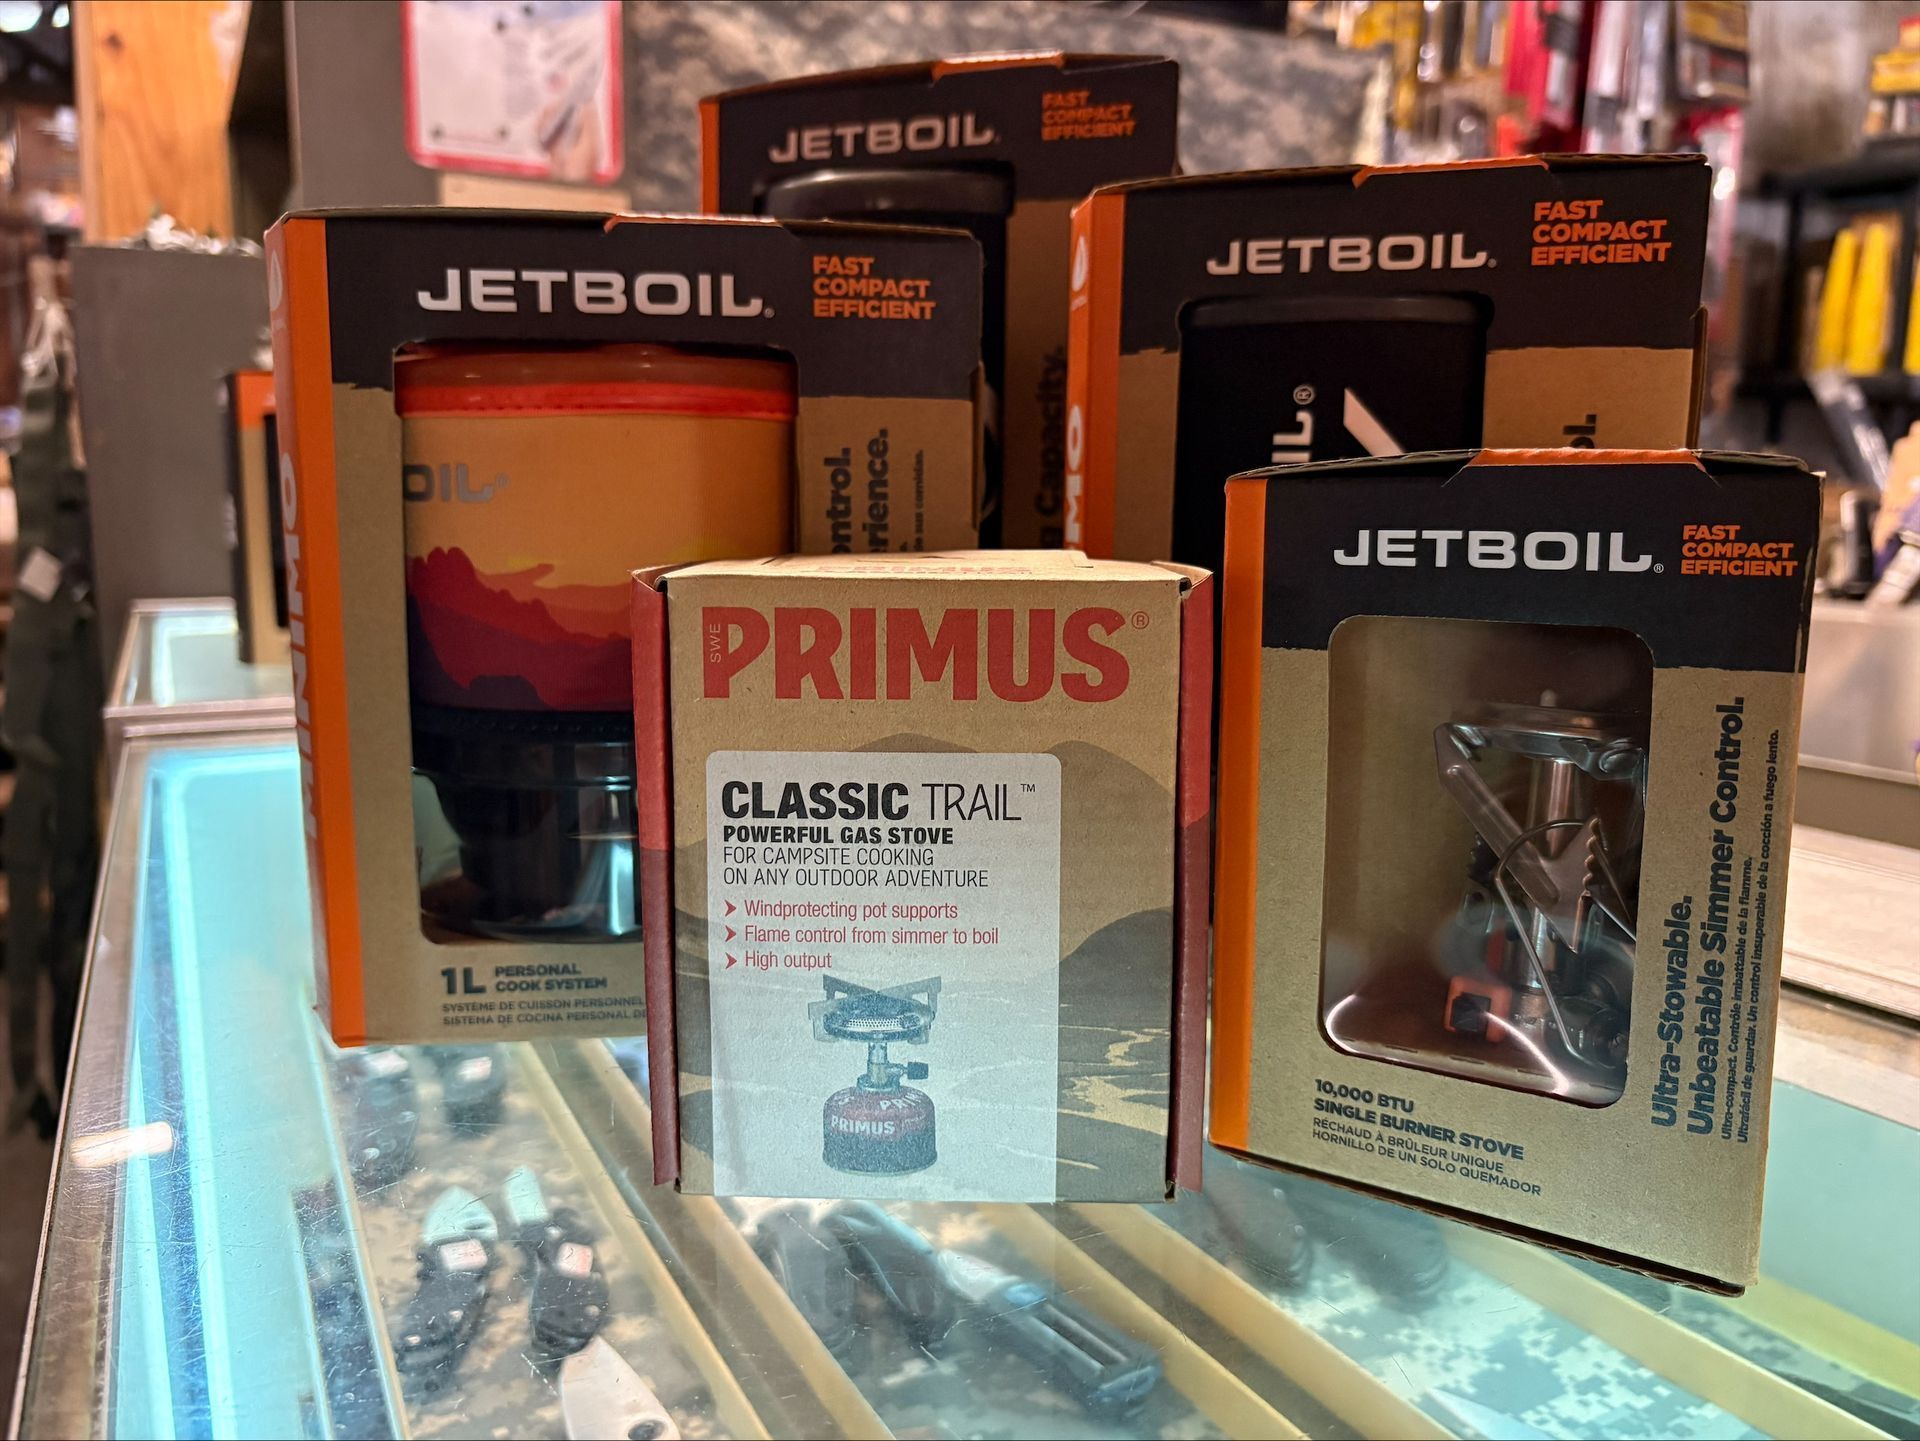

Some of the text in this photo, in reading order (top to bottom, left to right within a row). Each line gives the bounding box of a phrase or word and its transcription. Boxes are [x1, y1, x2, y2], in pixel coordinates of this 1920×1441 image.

[1042, 91, 1090, 107] FAST
[1042, 105, 1134, 124] COMPACT
[1042, 121, 1136, 141] EFFICIENT
[1533, 200, 1603, 221] FAST
[1532, 220, 1668, 243] COMPACT
[1531, 242, 1672, 266] EFFICIENT
[812, 256, 875, 275] FAST
[812, 277, 931, 298] COMPACT
[812, 299, 936, 320] EFFICIENT
[862, 428, 888, 553] rience.
[1682, 525, 1740, 541] FAST
[1681, 542, 1794, 560] COMPACT
[1680, 560, 1799, 577] EFFICIENT
[709, 623, 721, 663] SWE
[1765, 729, 1780, 764] lento.
[1763, 767, 1778, 802] fuego
[722, 780, 908, 821] CLASSIC
[723, 825, 953, 845] POWERFUL GAS STOVE
[1760, 813, 1773, 859] cocción
[724, 846, 934, 866] FOR CAMPSITE COOKING
[724, 868, 989, 887] ON ANY OUTDOOR ADVENTURE
[1758, 862, 1769, 872] la
[1757, 874, 1768, 889] de
[745, 900, 958, 921] Windprotecting pot supports
[1687, 697, 1745, 1135] Unbeatable Simmer Control.
[745, 925, 999, 945] Flame control from simmer to boil
[1751, 892, 1766, 961] insuperable
[495, 963, 581, 977] PERSONAL
[745, 950, 832, 971] High output
[495, 977, 608, 993] COOK SYSTEM
[1749, 962, 1761, 1003] control
[499, 1000, 514, 1011] DE
[518, 998, 571, 1011] CUISSON
[1721, 856, 1753, 1140] Ultra-compact. Contrôle imbattable de la flamme.
[443, 1013, 496, 1025] SISTEMA
[498, 1012, 513, 1024] DE
[516, 1011, 562, 1023] COCINA
[566, 1009, 631, 1021] PERSONAL
[1651, 896, 1692, 1127] Ultra-Stowable.
[1747, 1006, 1758, 1021] Un
[1744, 1024, 1758, 1073] guardar.
[1741, 1075, 1753, 1088] de
[1315, 1079, 1414, 1113] 10,000 BTU
[831, 1115, 896, 1135] PRIMUS
[1737, 1091, 1752, 1143] Ultrafácil
[1314, 1098, 1524, 1160] SINGLE BURNER STOVE
[1313, 1117, 1504, 1173] RÉCHAUD À BRÛLEUR UNIQUE
[1312, 1130, 1542, 1196] HORNILLO DE UN SOLO QUEMADOR
